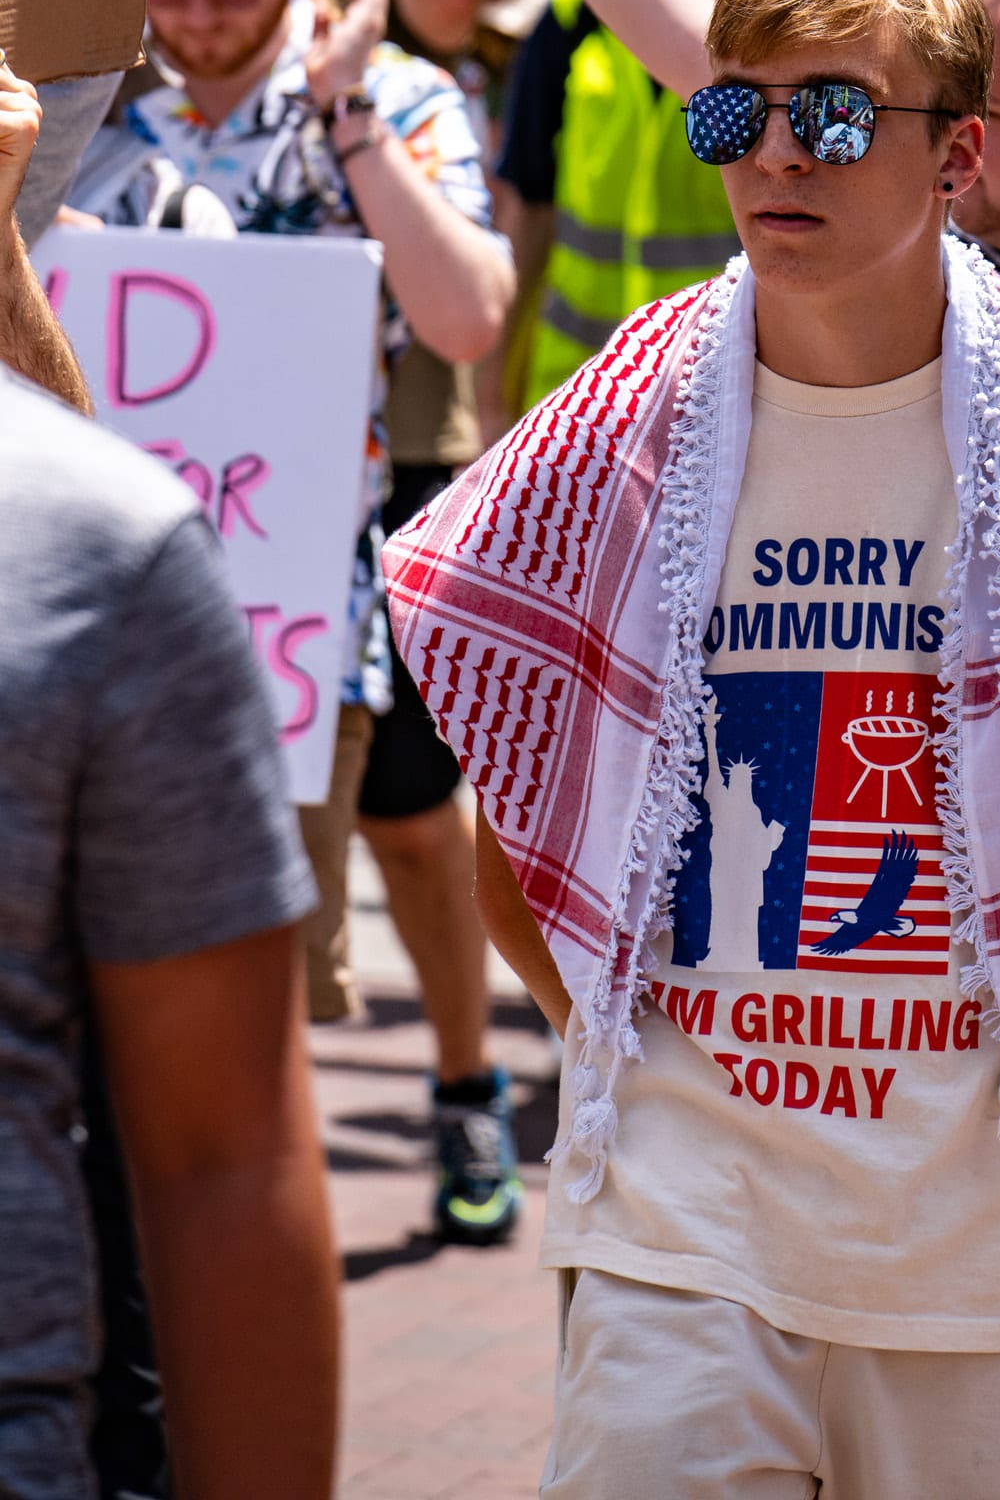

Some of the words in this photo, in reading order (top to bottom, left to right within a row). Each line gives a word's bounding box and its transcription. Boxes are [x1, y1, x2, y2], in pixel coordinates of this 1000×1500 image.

[752, 537, 926, 588] SORRY
[730, 992, 983, 1052] GRILLING
[713, 1051, 897, 1120] TODAY
